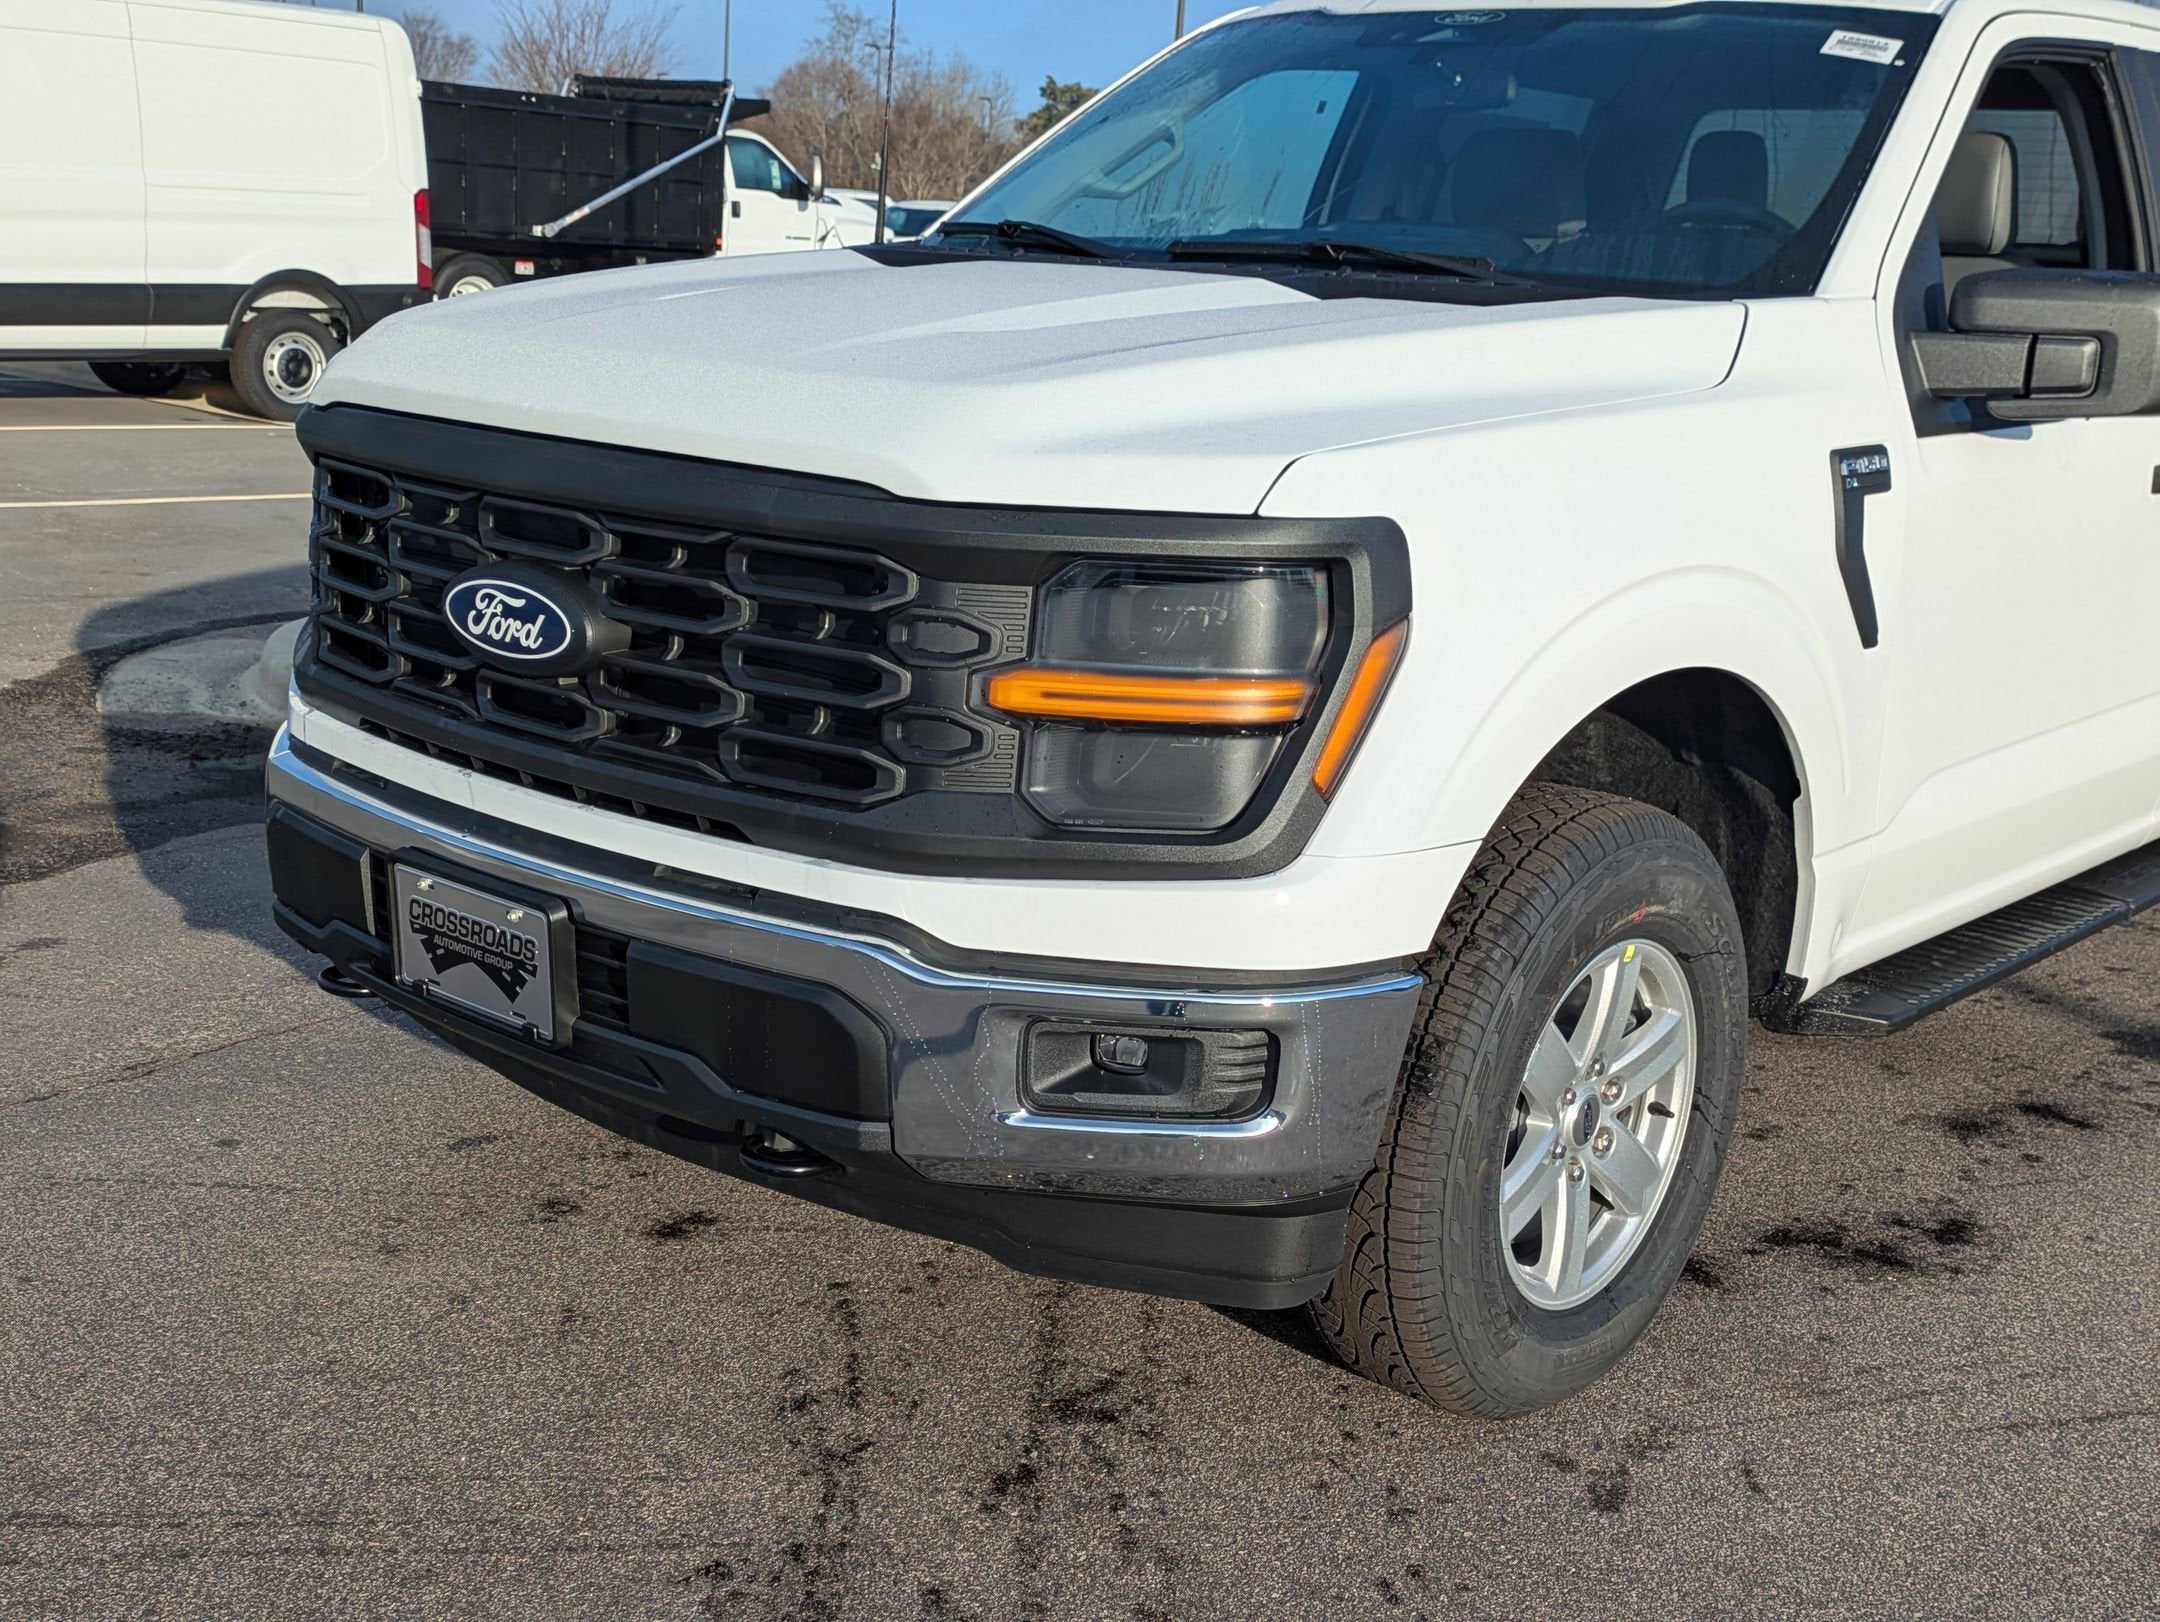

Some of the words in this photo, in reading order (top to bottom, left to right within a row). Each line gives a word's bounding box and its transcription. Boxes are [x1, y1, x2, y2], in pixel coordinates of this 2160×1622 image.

[467, 588, 546, 650] Ford
[408, 897, 538, 963] CROSSROADS
[433, 934, 484, 962] AUTOMOTIVE
[484, 954, 514, 972] GROUP
